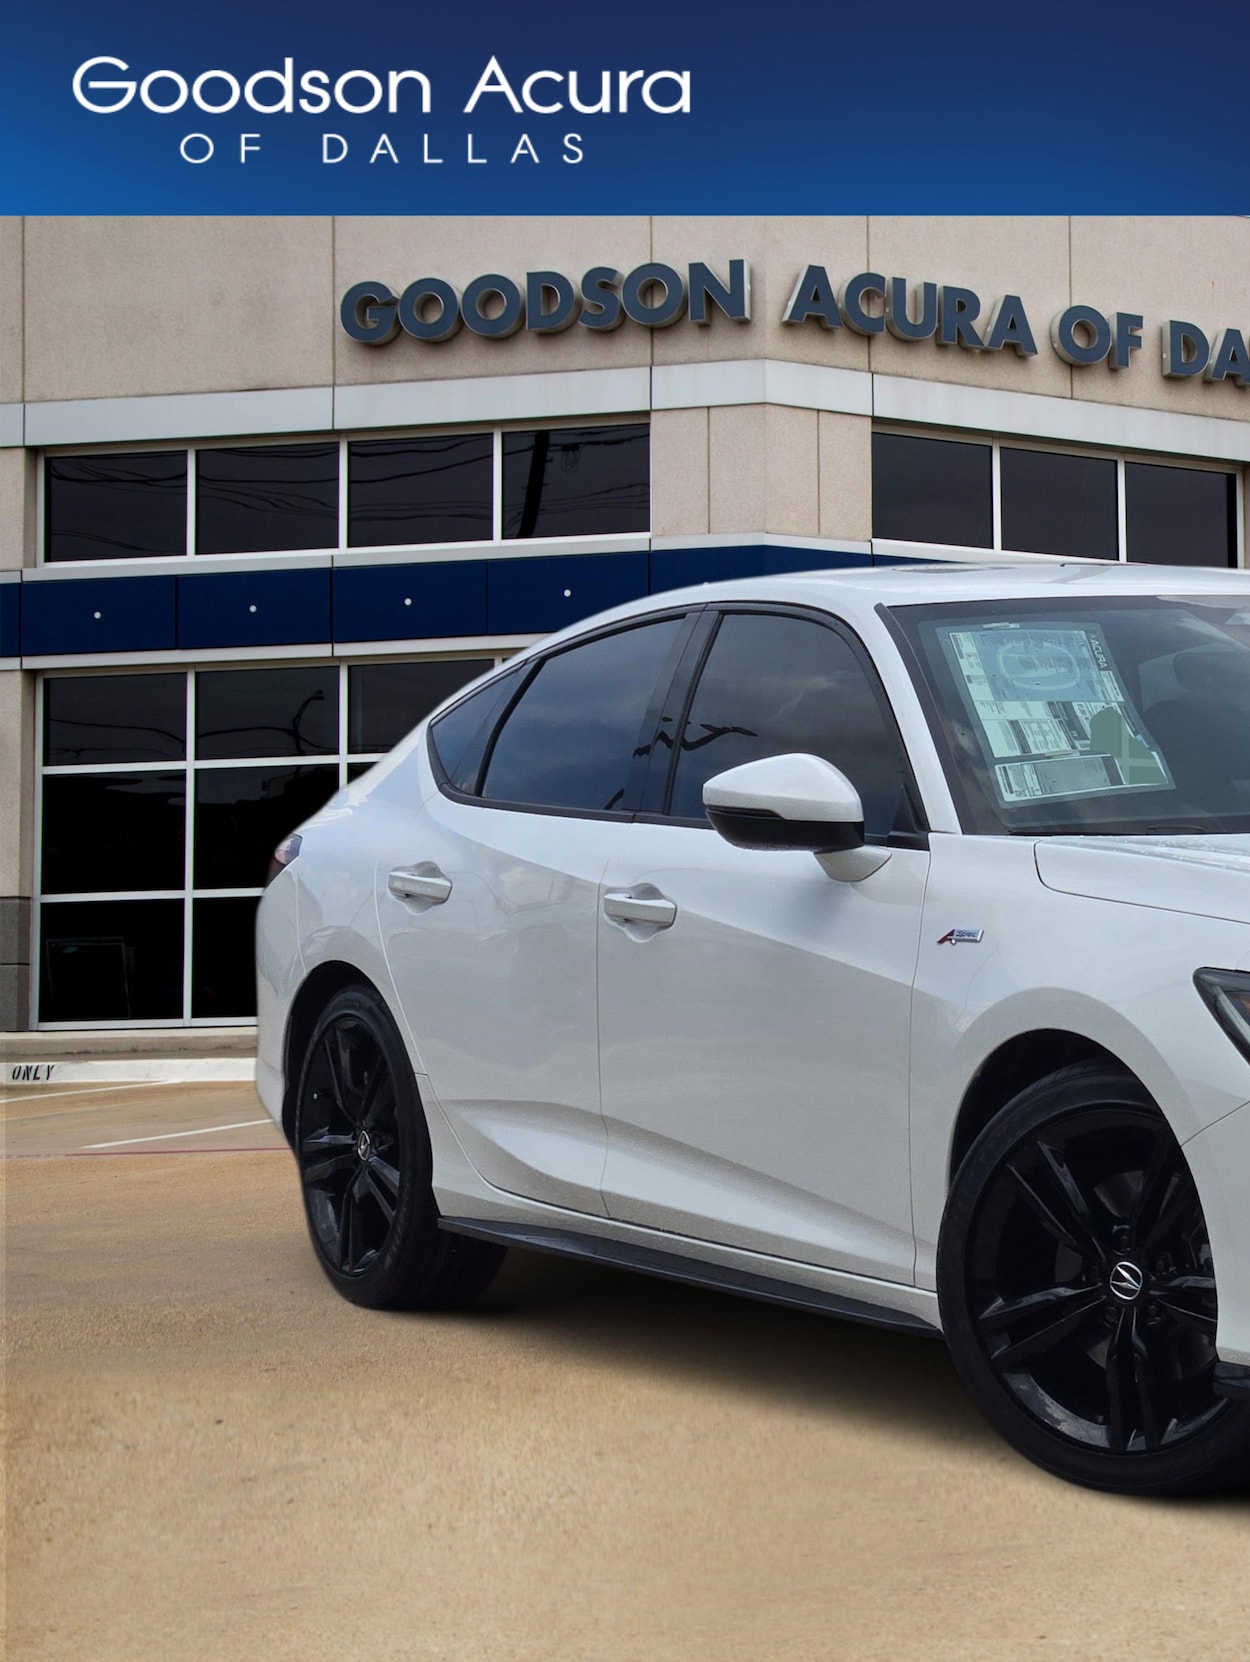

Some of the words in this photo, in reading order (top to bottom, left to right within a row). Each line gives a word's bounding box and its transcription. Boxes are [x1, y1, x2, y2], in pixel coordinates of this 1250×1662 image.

[340, 259, 750, 345] GOODSON
[781, 264, 1038, 358] ACURA
[1052, 304, 1144, 370] OF
[1090, 639, 1108, 669] ACURA
[12, 1064, 55, 1080] ONLY
